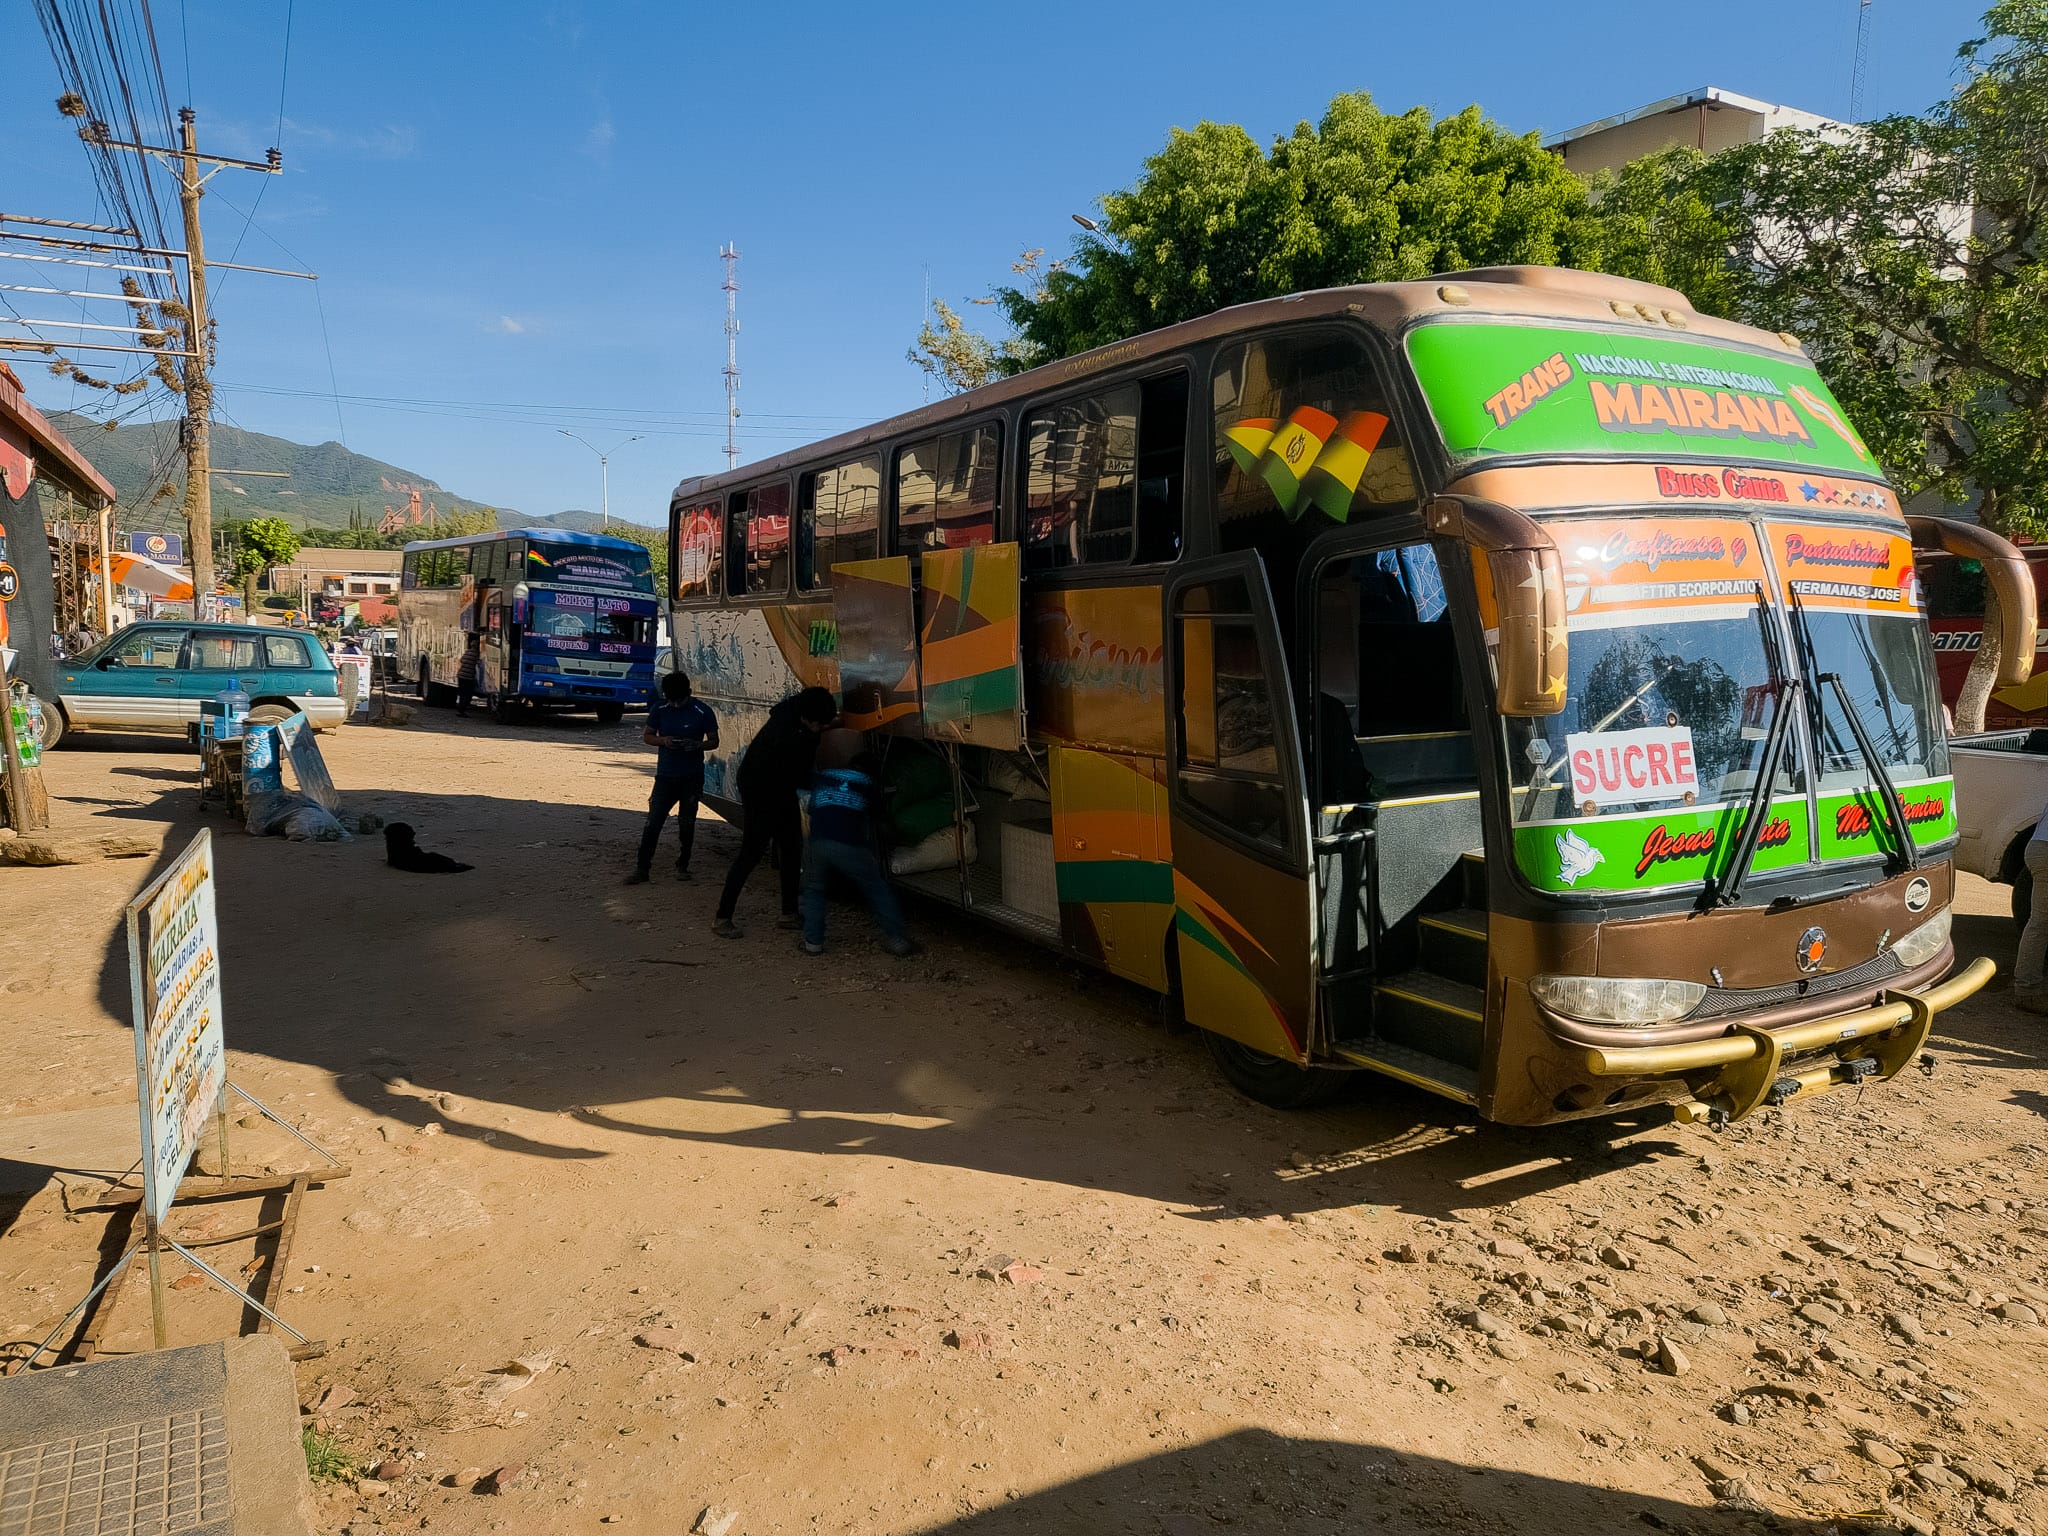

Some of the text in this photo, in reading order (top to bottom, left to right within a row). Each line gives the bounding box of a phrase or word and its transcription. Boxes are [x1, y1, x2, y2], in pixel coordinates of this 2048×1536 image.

[1485, 352, 1574, 429] TRANS
[1573, 353, 1784, 398] NACIONAL E INTERNACIONAL
[1588, 381, 1814, 447] MAIRANA
[1655, 466, 1789, 502] Buss Cama
[1731, 536, 1748, 569] y
[1785, 533, 1890, 570] Puntualidad
[555, 593, 630, 611] MIKE LITO
[1791, 580, 1901, 602] HERMANAS JOSE
[547, 639, 589, 651] PEQUEÑO
[1573, 741, 1695, 794] SUCRE
[1836, 803, 1873, 841] Mi
[1634, 824, 1716, 879] Jesus
[199, 927, 204, 946] A
[152, 946, 213, 1063] OCHABAMBA
[186, 1001, 194, 1025] PM
[206, 972, 215, 996] PM
